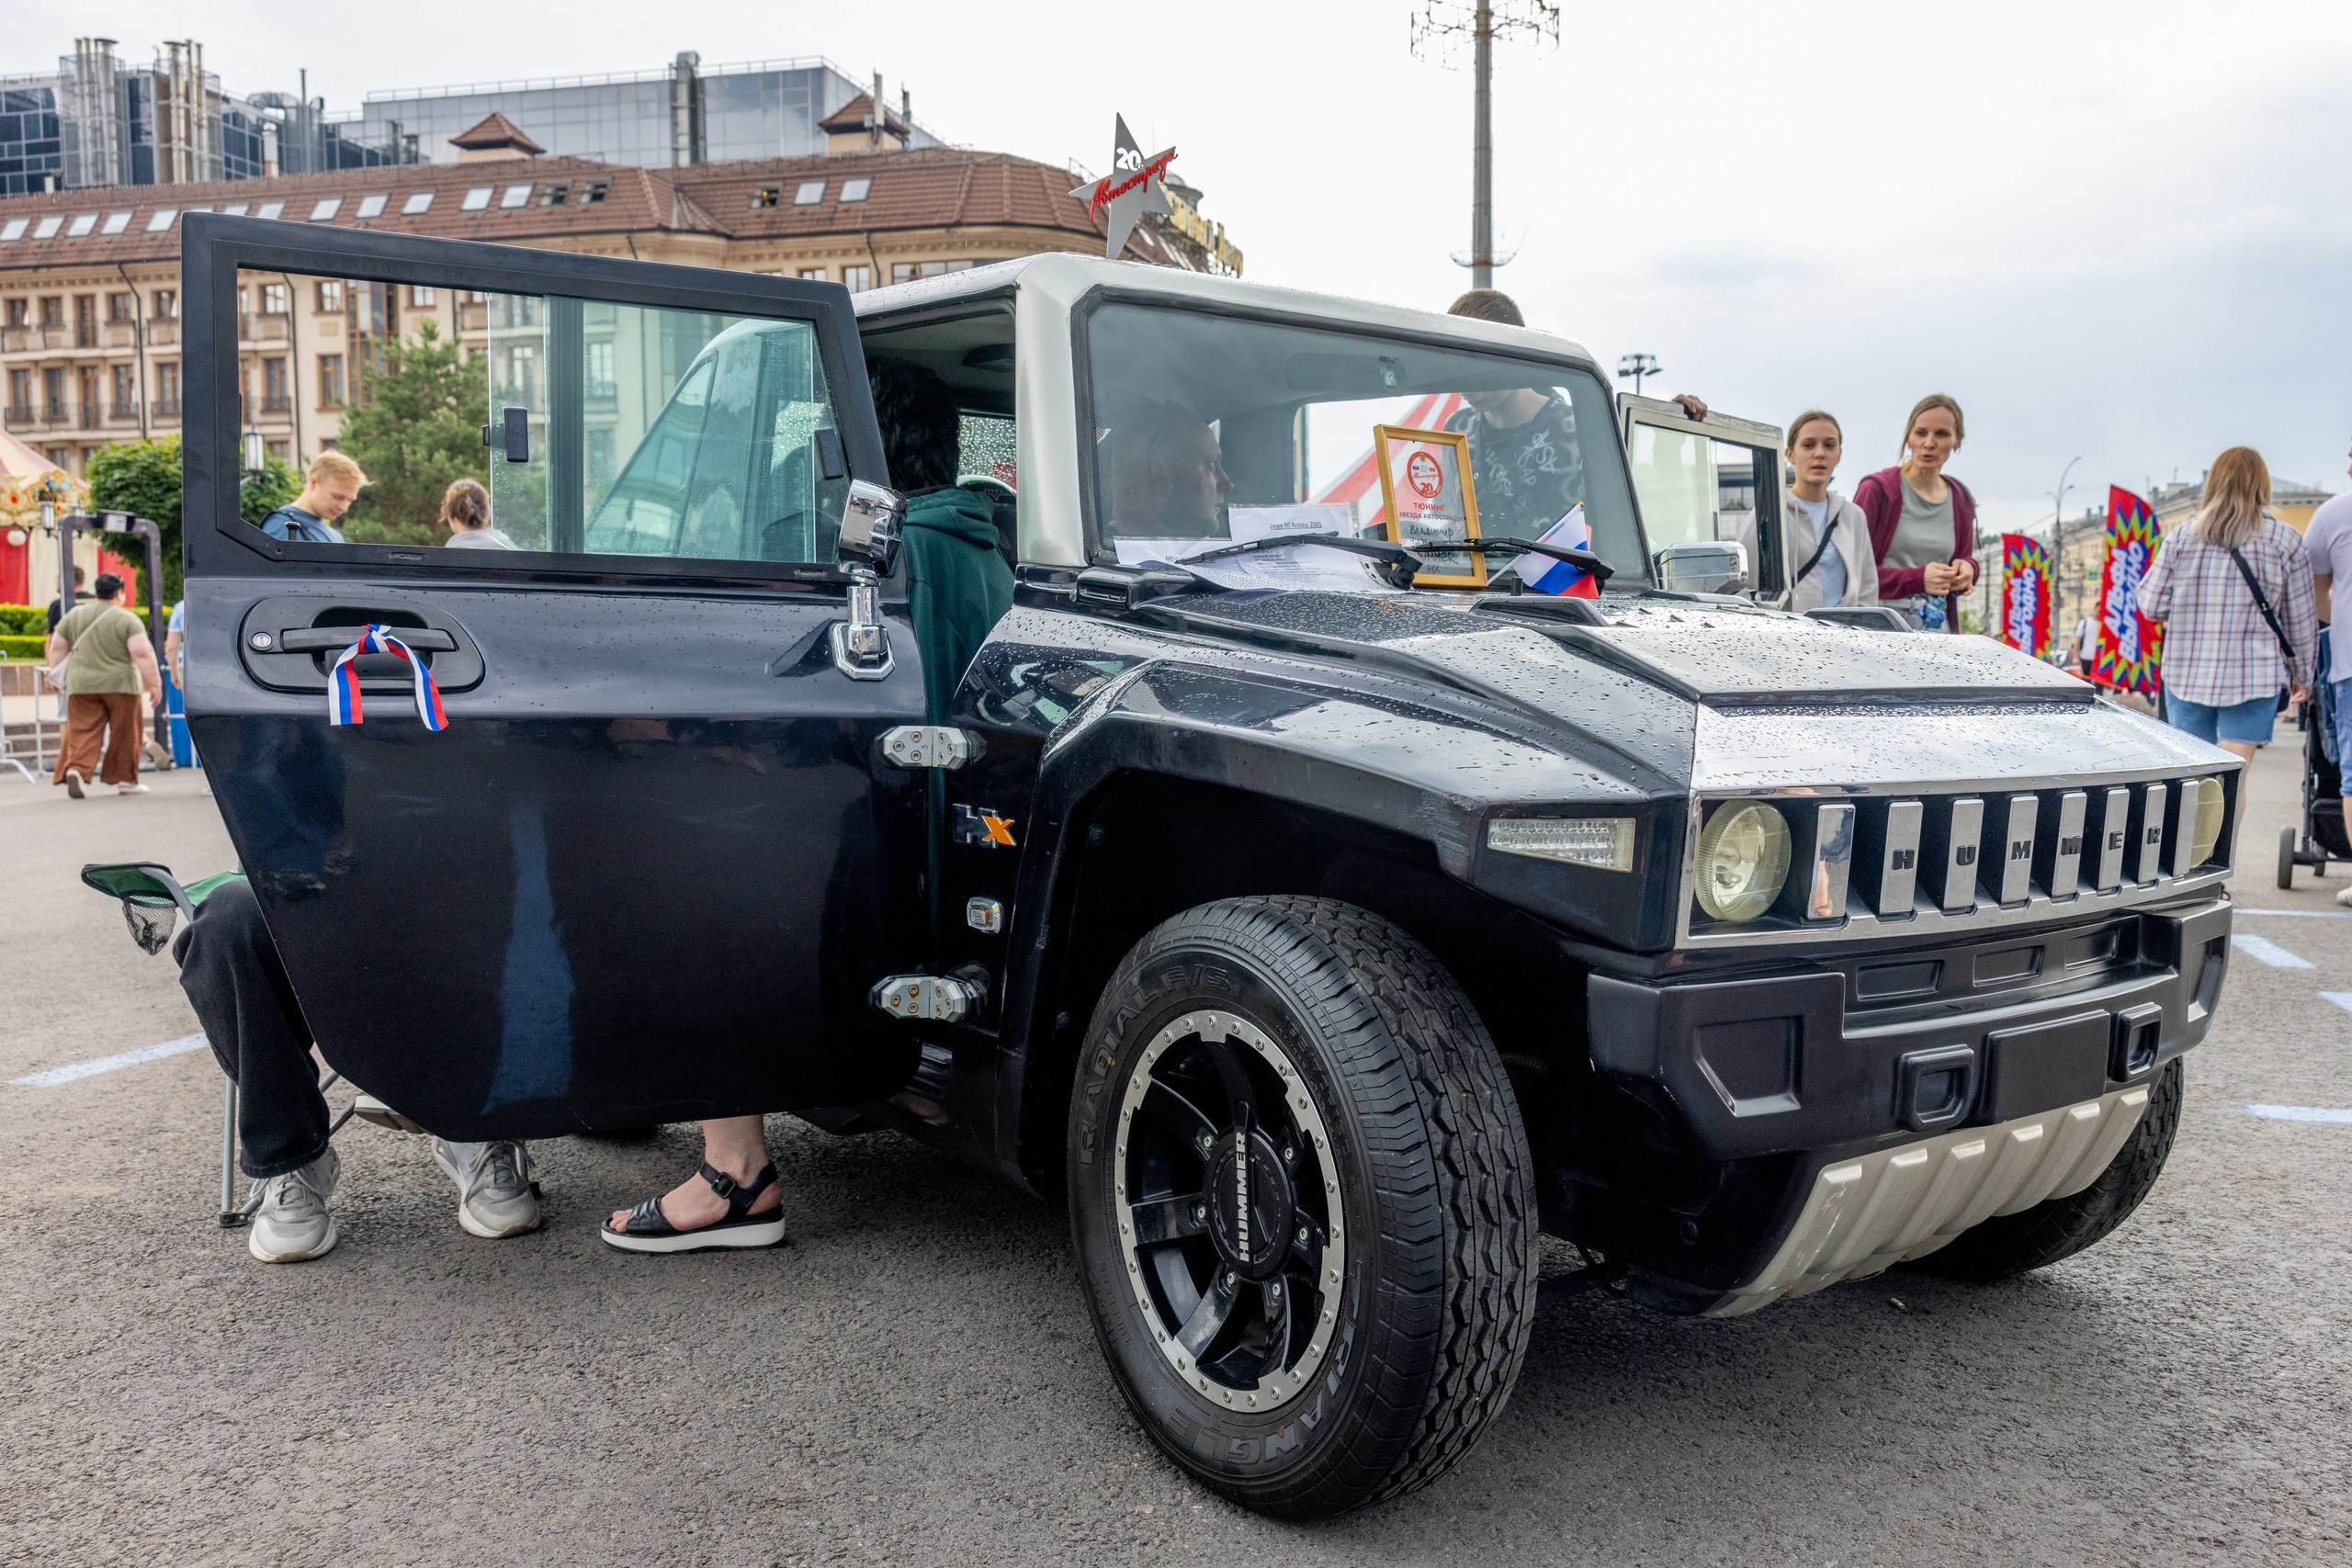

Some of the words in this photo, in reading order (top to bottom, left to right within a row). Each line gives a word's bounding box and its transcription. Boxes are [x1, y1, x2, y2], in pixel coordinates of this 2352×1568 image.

[1115, 147, 1142, 172] 20
[1413, 502, 1446, 512] ТЮНИНГ
[1423, 513, 1464, 522] АВТОСТРАДЫ
[2008, 577, 2023, 642] АЛЬФА
[2104, 547, 2128, 638] АЛЬФА
[2118, 540, 2143, 663] ВЫГОДНО
[1892, 826, 2161, 870] HUMMER
[1079, 987, 1160, 1165] RADIAL
[1236, 1132, 1250, 1262] HUMMER
[1168, 1259, 1363, 1466] TRIANGLE
